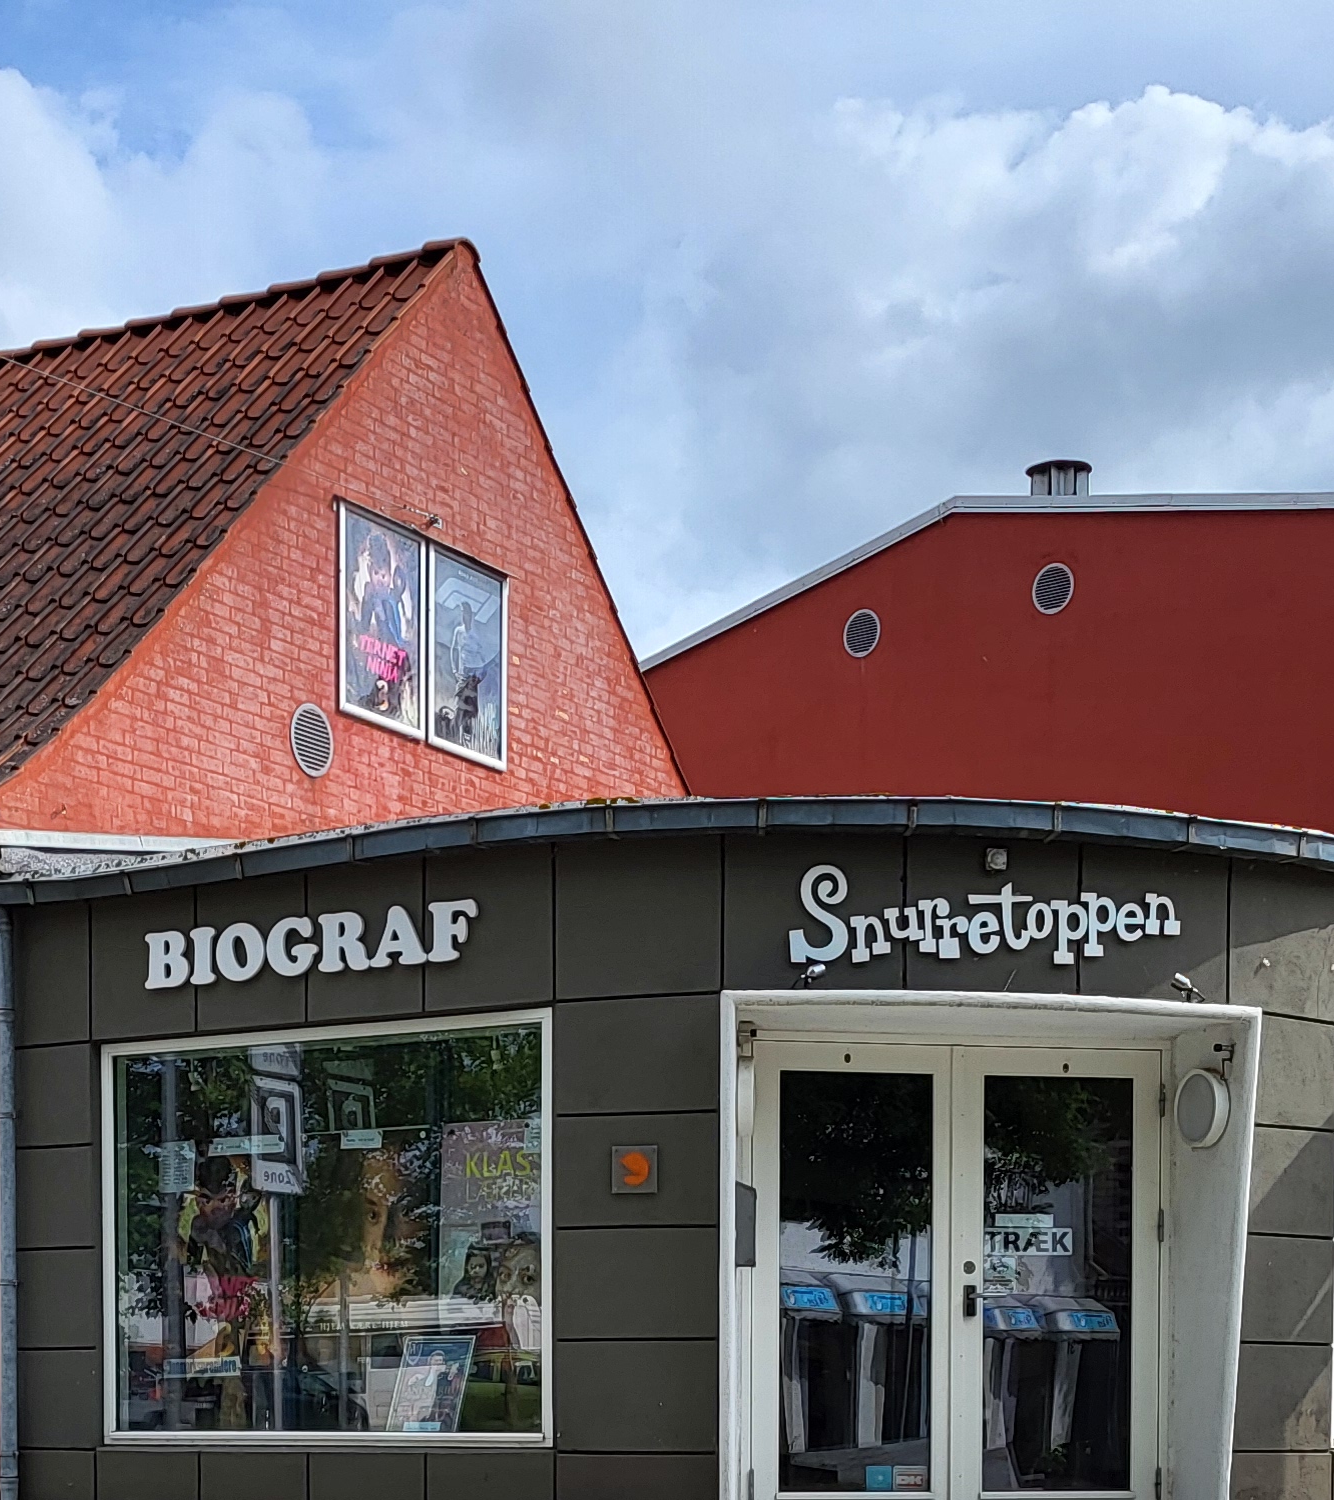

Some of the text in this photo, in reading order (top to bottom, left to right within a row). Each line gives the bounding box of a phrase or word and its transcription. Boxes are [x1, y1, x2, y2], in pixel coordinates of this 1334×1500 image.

[359, 634, 407, 666] TERNET
[375, 680, 389, 711] 3
[789, 864, 1181, 965] Snurretoppen
[144, 899, 479, 990] BIOGRAF
[985, 1231, 1070, 1252] TRÆK
